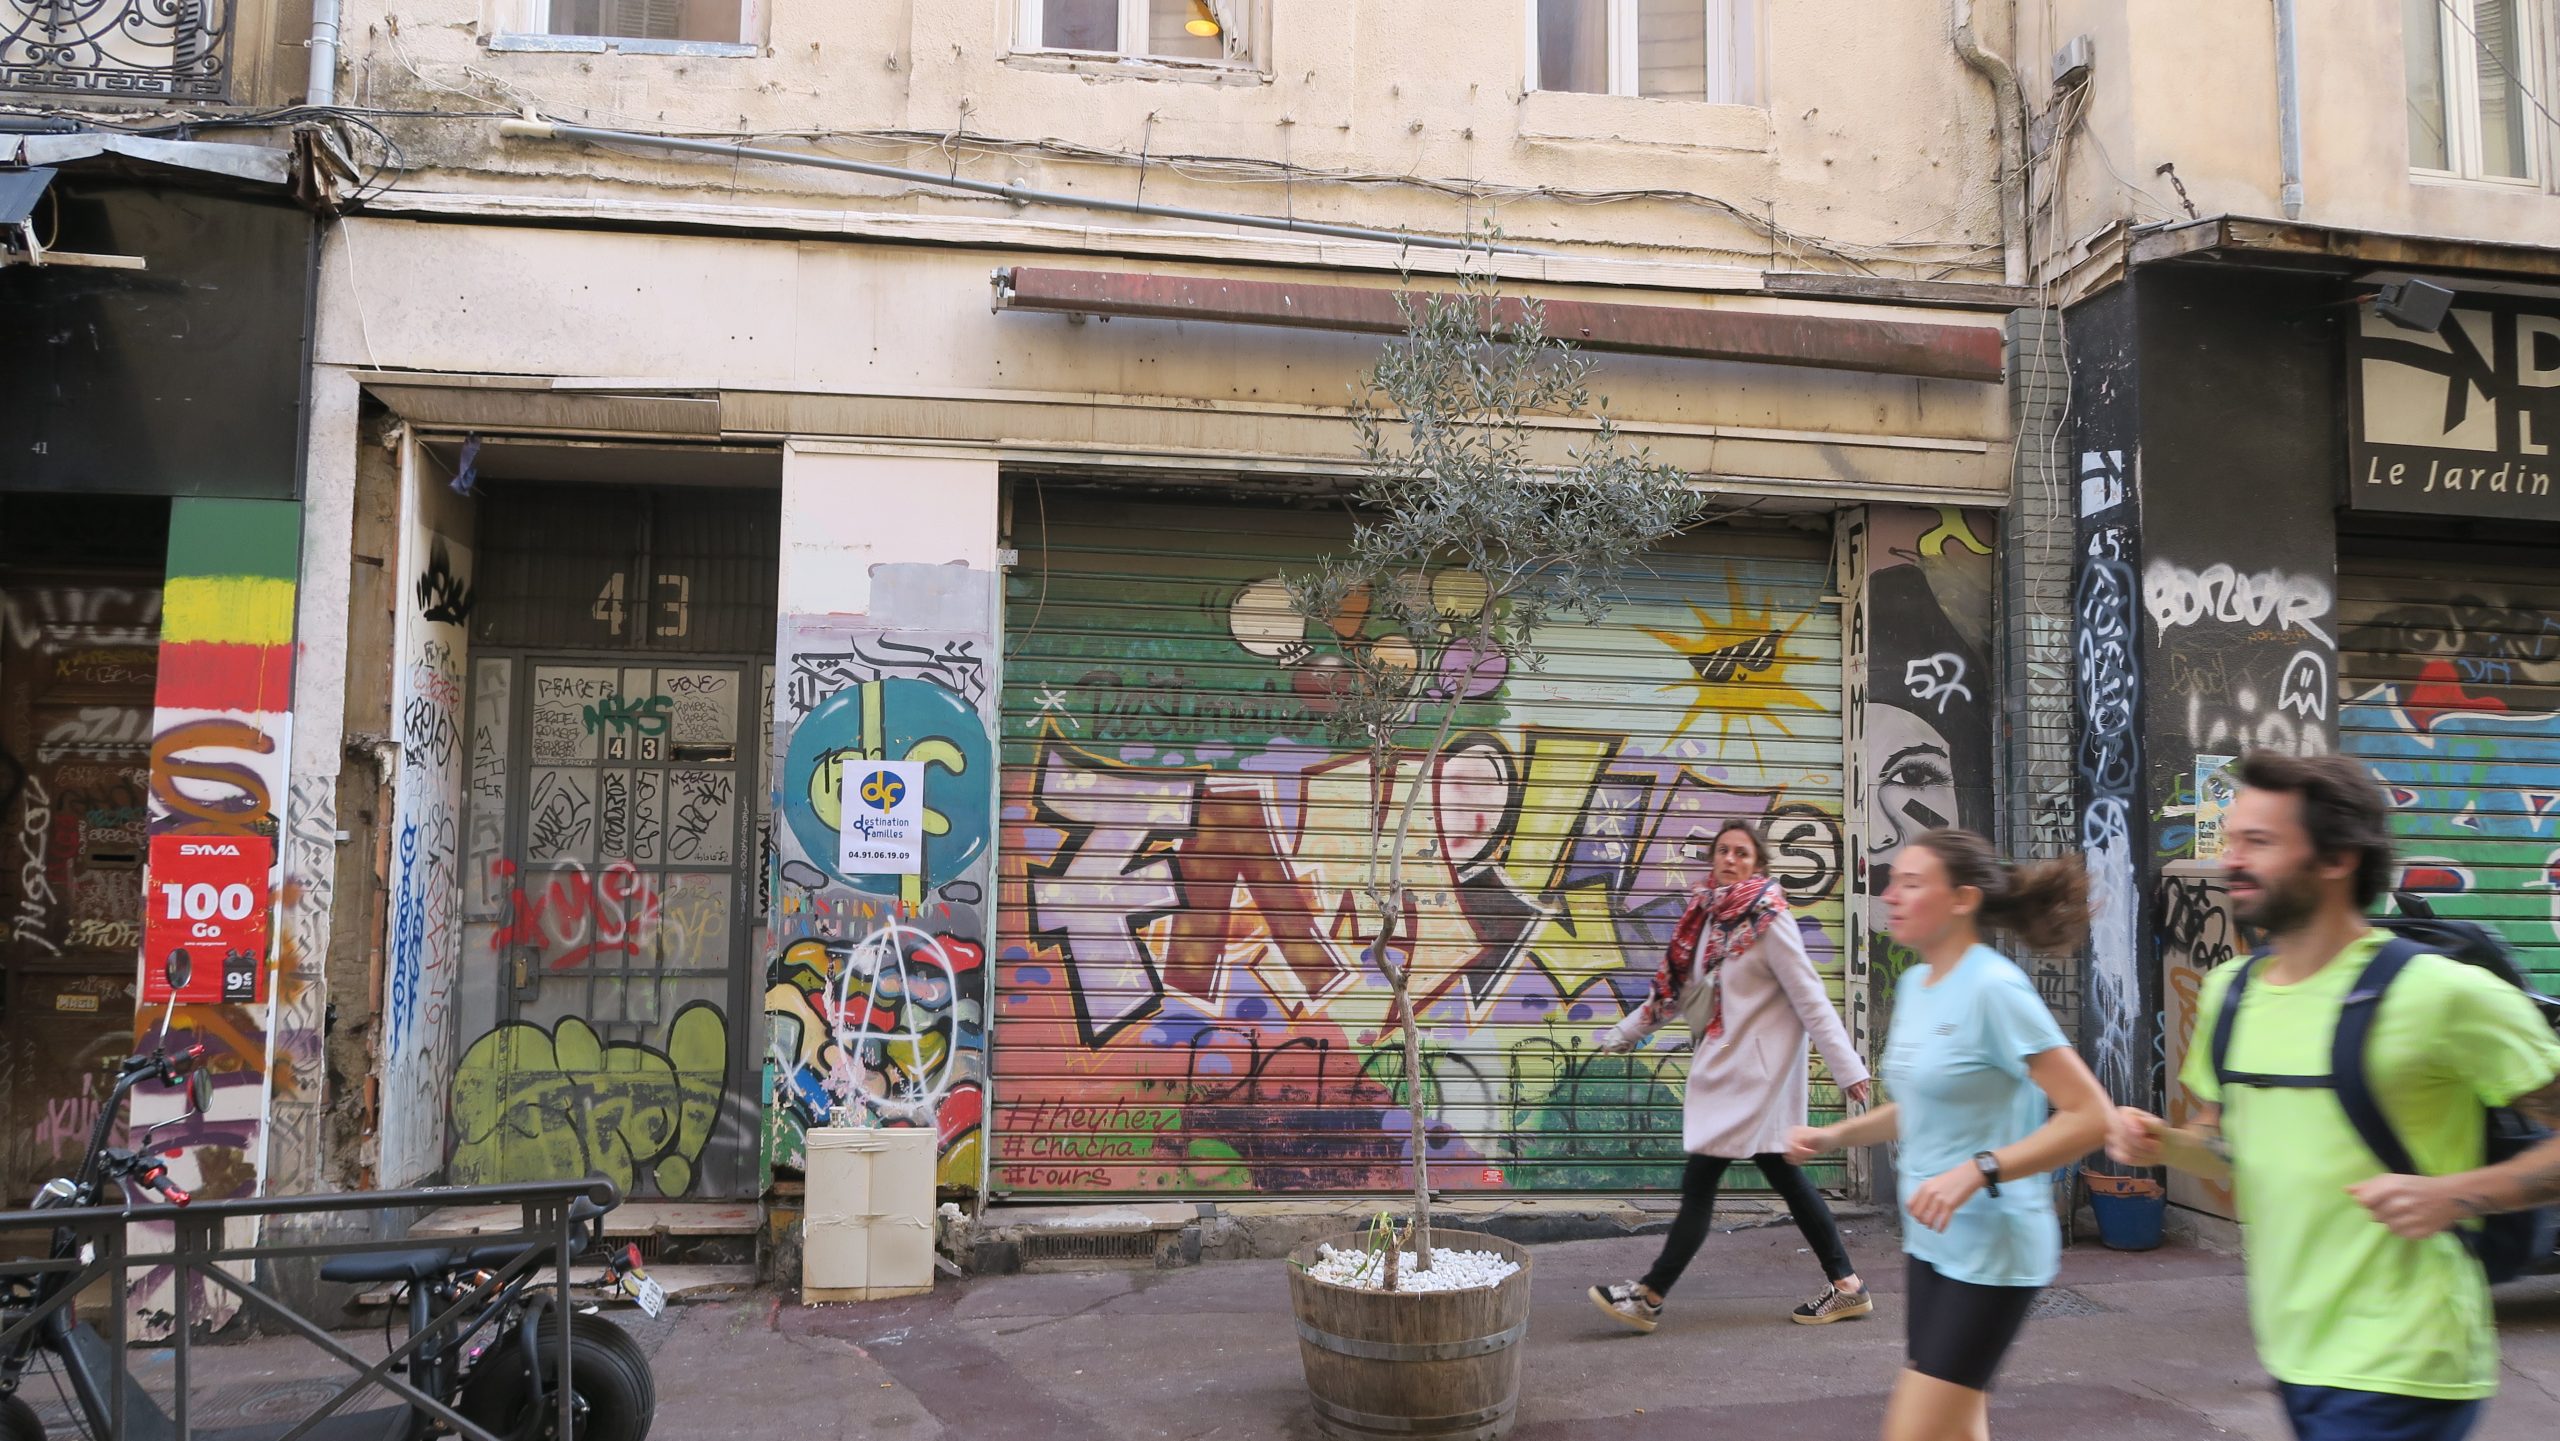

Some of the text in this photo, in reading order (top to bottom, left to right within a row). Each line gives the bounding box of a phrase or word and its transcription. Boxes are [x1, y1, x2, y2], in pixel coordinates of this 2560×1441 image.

[31, 442, 48, 454] 41
[2368, 456, 2549, 496] Le Jardin
[592, 572, 689, 638] 43
[853, 814, 909, 830] destination
[864, 826, 903, 841] familles
[180, 844, 240, 856] SYMA
[848, 851, 910, 859] 04.91.06.19.09
[162, 883, 254, 921] 100
[191, 922, 221, 938] Go
